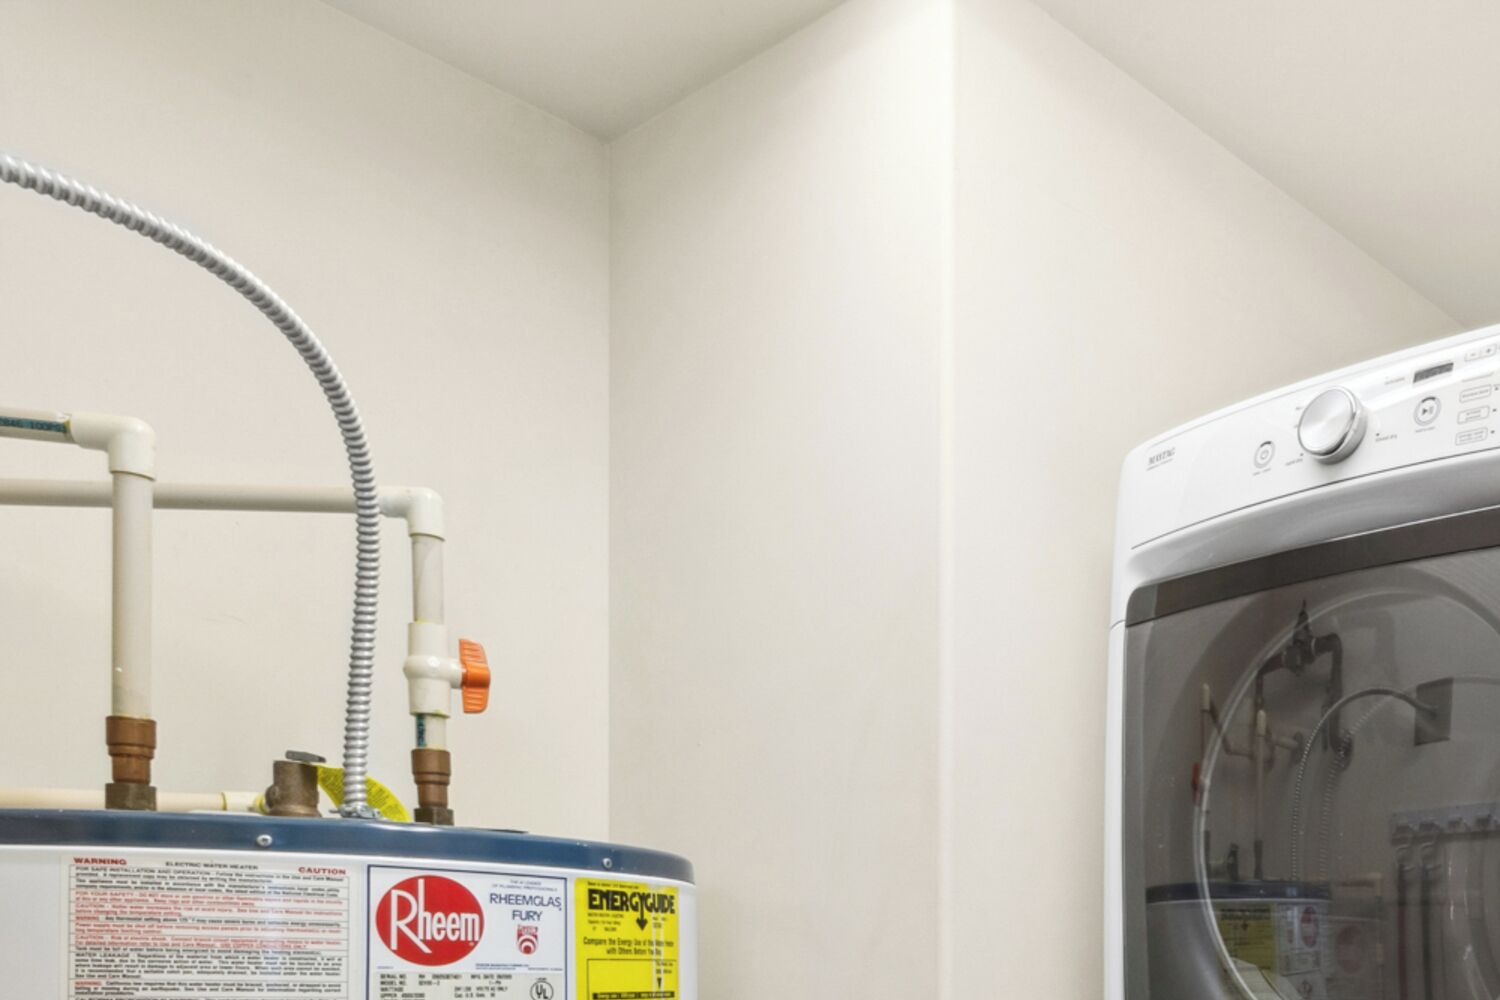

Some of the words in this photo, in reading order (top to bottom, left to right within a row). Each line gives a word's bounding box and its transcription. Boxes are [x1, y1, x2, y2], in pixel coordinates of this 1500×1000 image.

[73, 857, 127, 865] WARNING
[298, 866, 346, 875] CAUTION
[390, 878, 480, 954] Rheem
[512, 909, 544, 921] FURY
